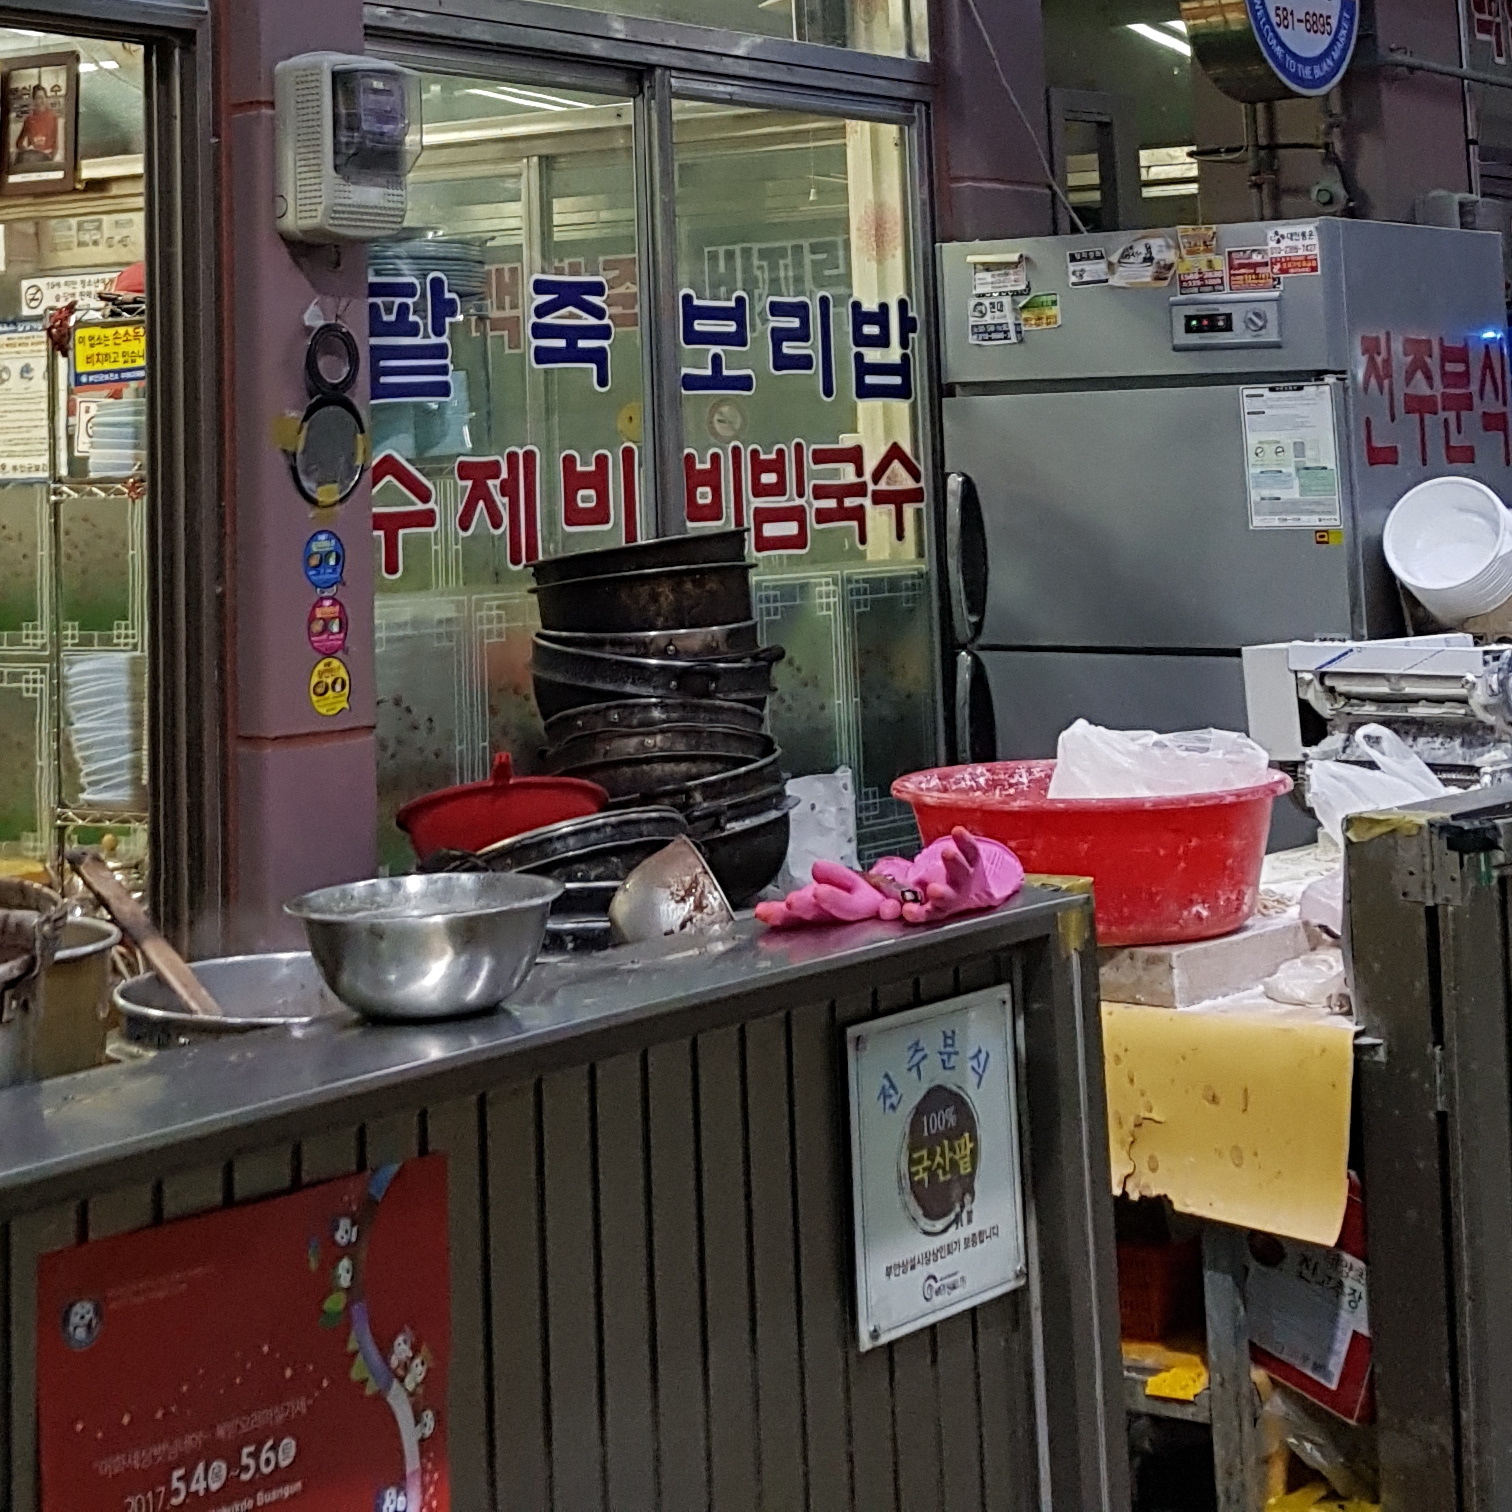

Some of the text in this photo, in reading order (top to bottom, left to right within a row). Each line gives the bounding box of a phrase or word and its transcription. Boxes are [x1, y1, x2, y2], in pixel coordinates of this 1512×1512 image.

[1275, 6, 1332, 36] 581-6895
[1286, 57, 1297, 73] TO
[1297, 62, 1313, 79] THE
[112, 327, 145, 345] 손소독
[680, 287, 920, 402] 보리밥
[369, 443, 642, 579] 수제비
[922, 1105, 957, 1136] 100%
[910, 1133, 974, 1188] 국산팥
